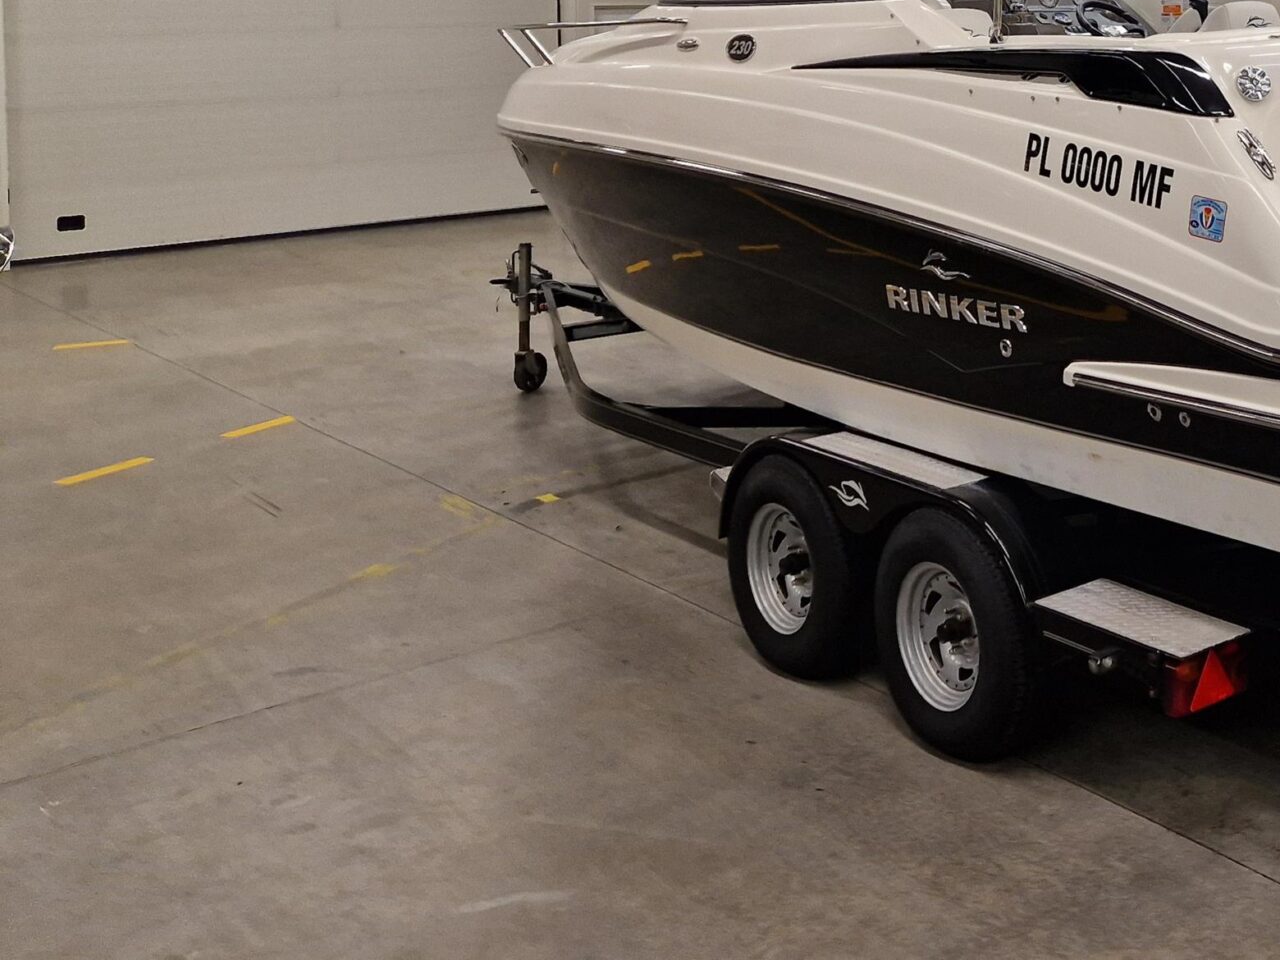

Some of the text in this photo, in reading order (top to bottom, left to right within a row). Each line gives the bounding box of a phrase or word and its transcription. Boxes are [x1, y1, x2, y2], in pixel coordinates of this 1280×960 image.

[730, 40, 753, 55] 230
[1024, 132, 1175, 209] PL 0000 MF
[885, 284, 1028, 334] RINKER
